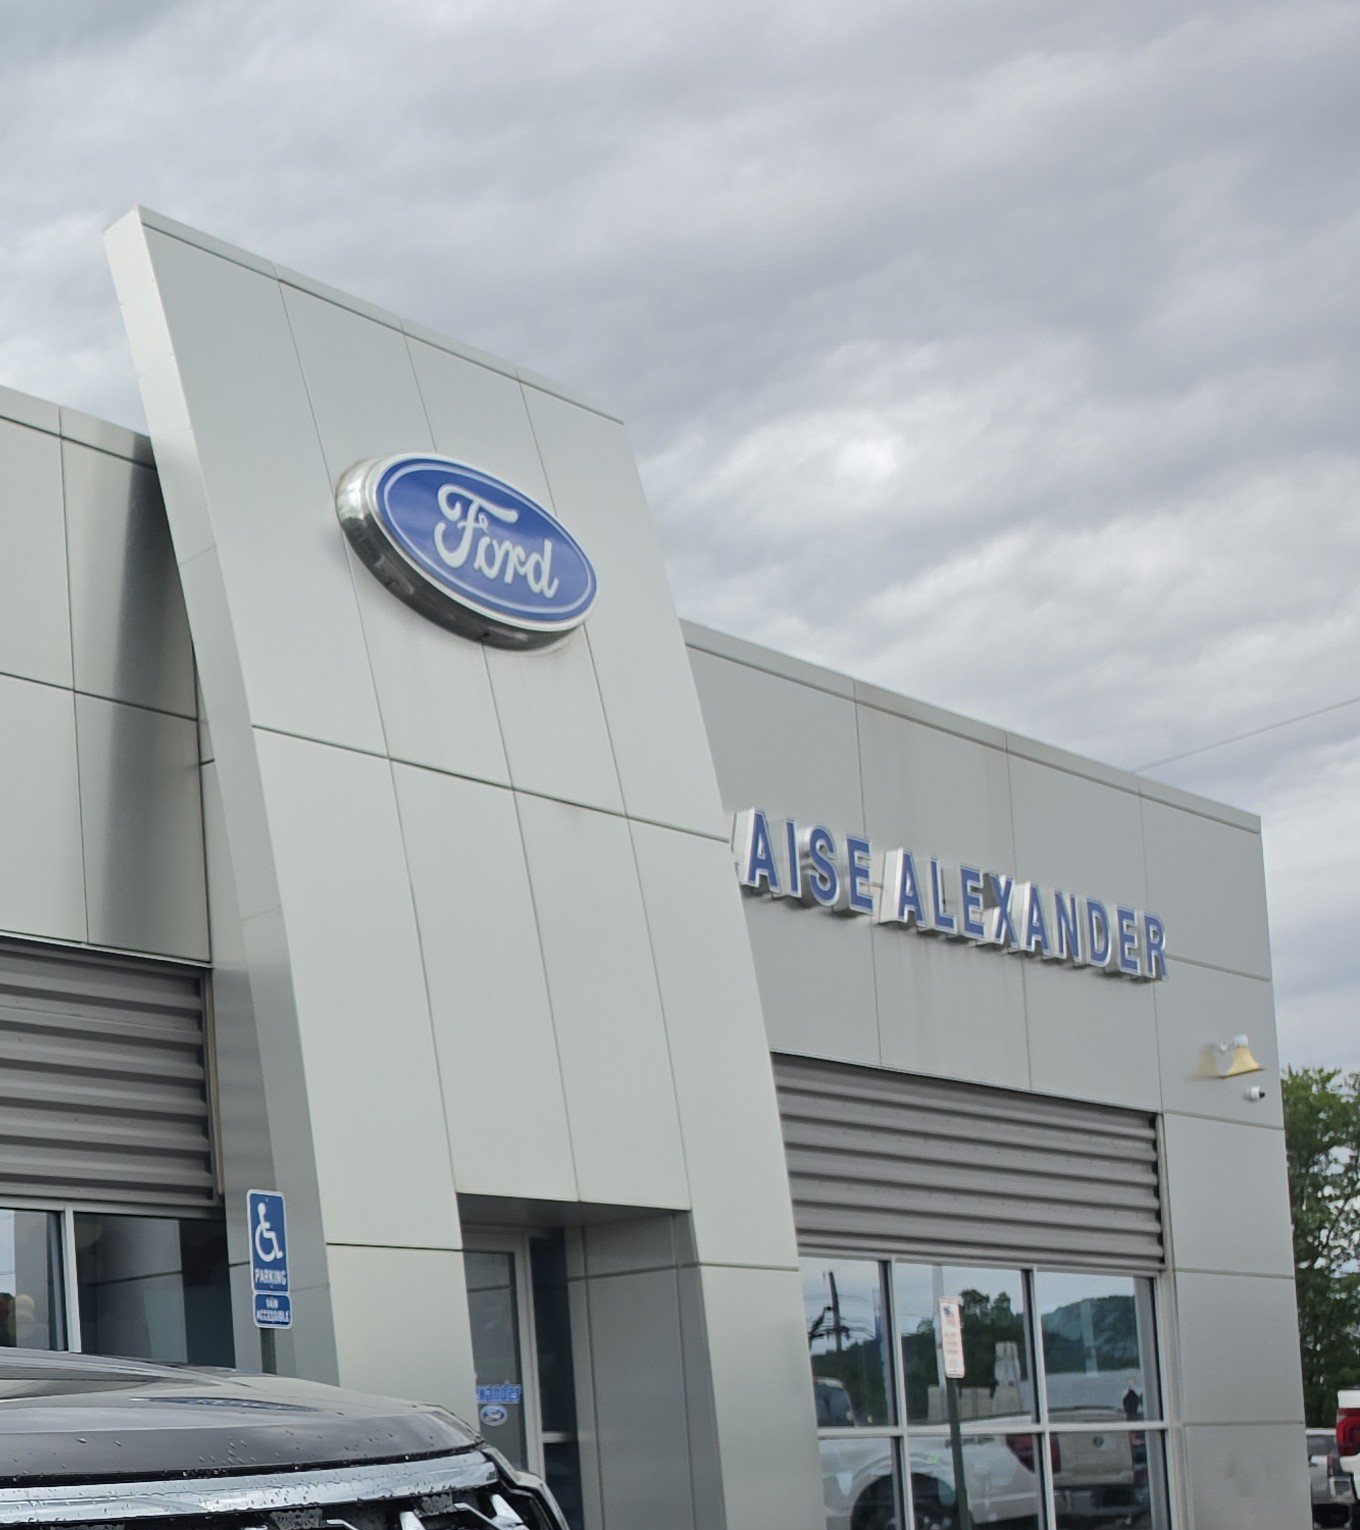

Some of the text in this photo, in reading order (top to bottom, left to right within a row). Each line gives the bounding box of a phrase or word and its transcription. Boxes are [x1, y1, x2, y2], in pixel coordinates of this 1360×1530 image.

[434, 483, 560, 598] Ford
[896, 847, 1168, 981] ALEXANDER
[254, 1268, 287, 1286] PARKING
